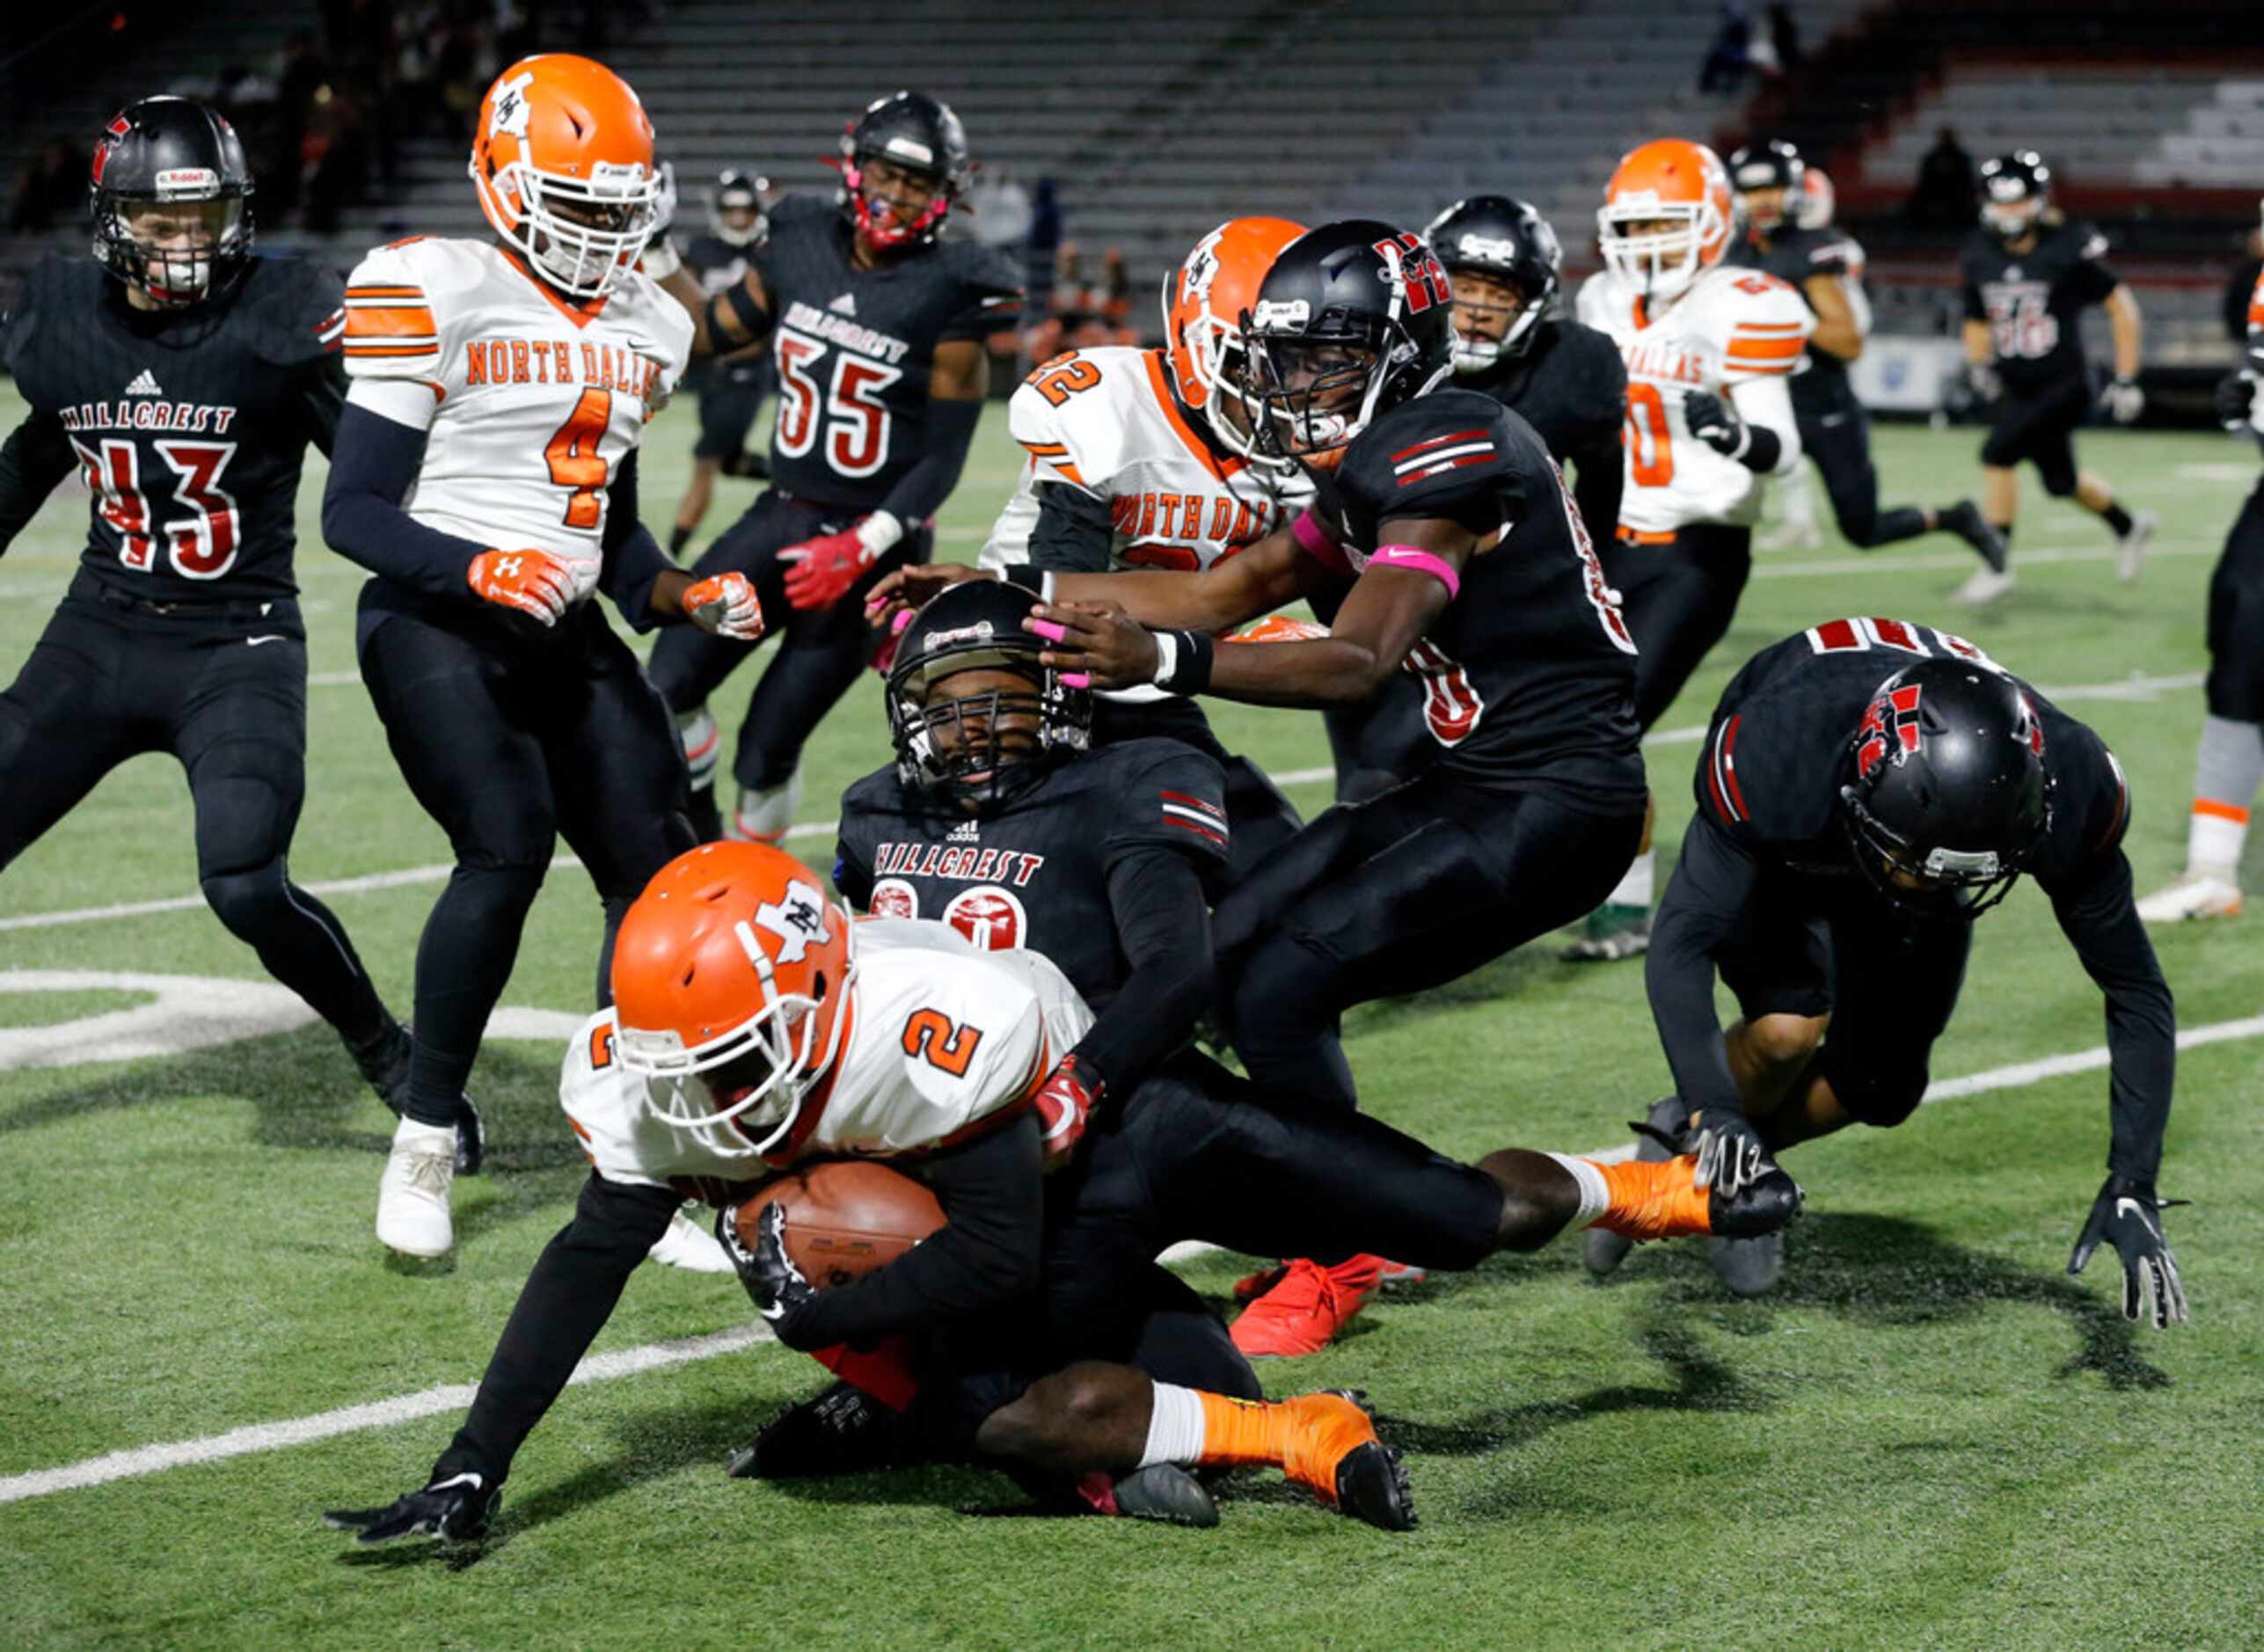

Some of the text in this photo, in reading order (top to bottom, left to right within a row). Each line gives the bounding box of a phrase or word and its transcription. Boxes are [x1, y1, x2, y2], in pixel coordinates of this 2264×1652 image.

[466, 340, 573, 385] NORTH
[59, 401, 237, 434] HILLCREST
[774, 326, 903, 478] 55
[543, 385, 612, 530] 4
[69, 435, 242, 581] 43
[874, 842, 1044, 887] HILLCREST
[901, 1007, 983, 1079] 2
